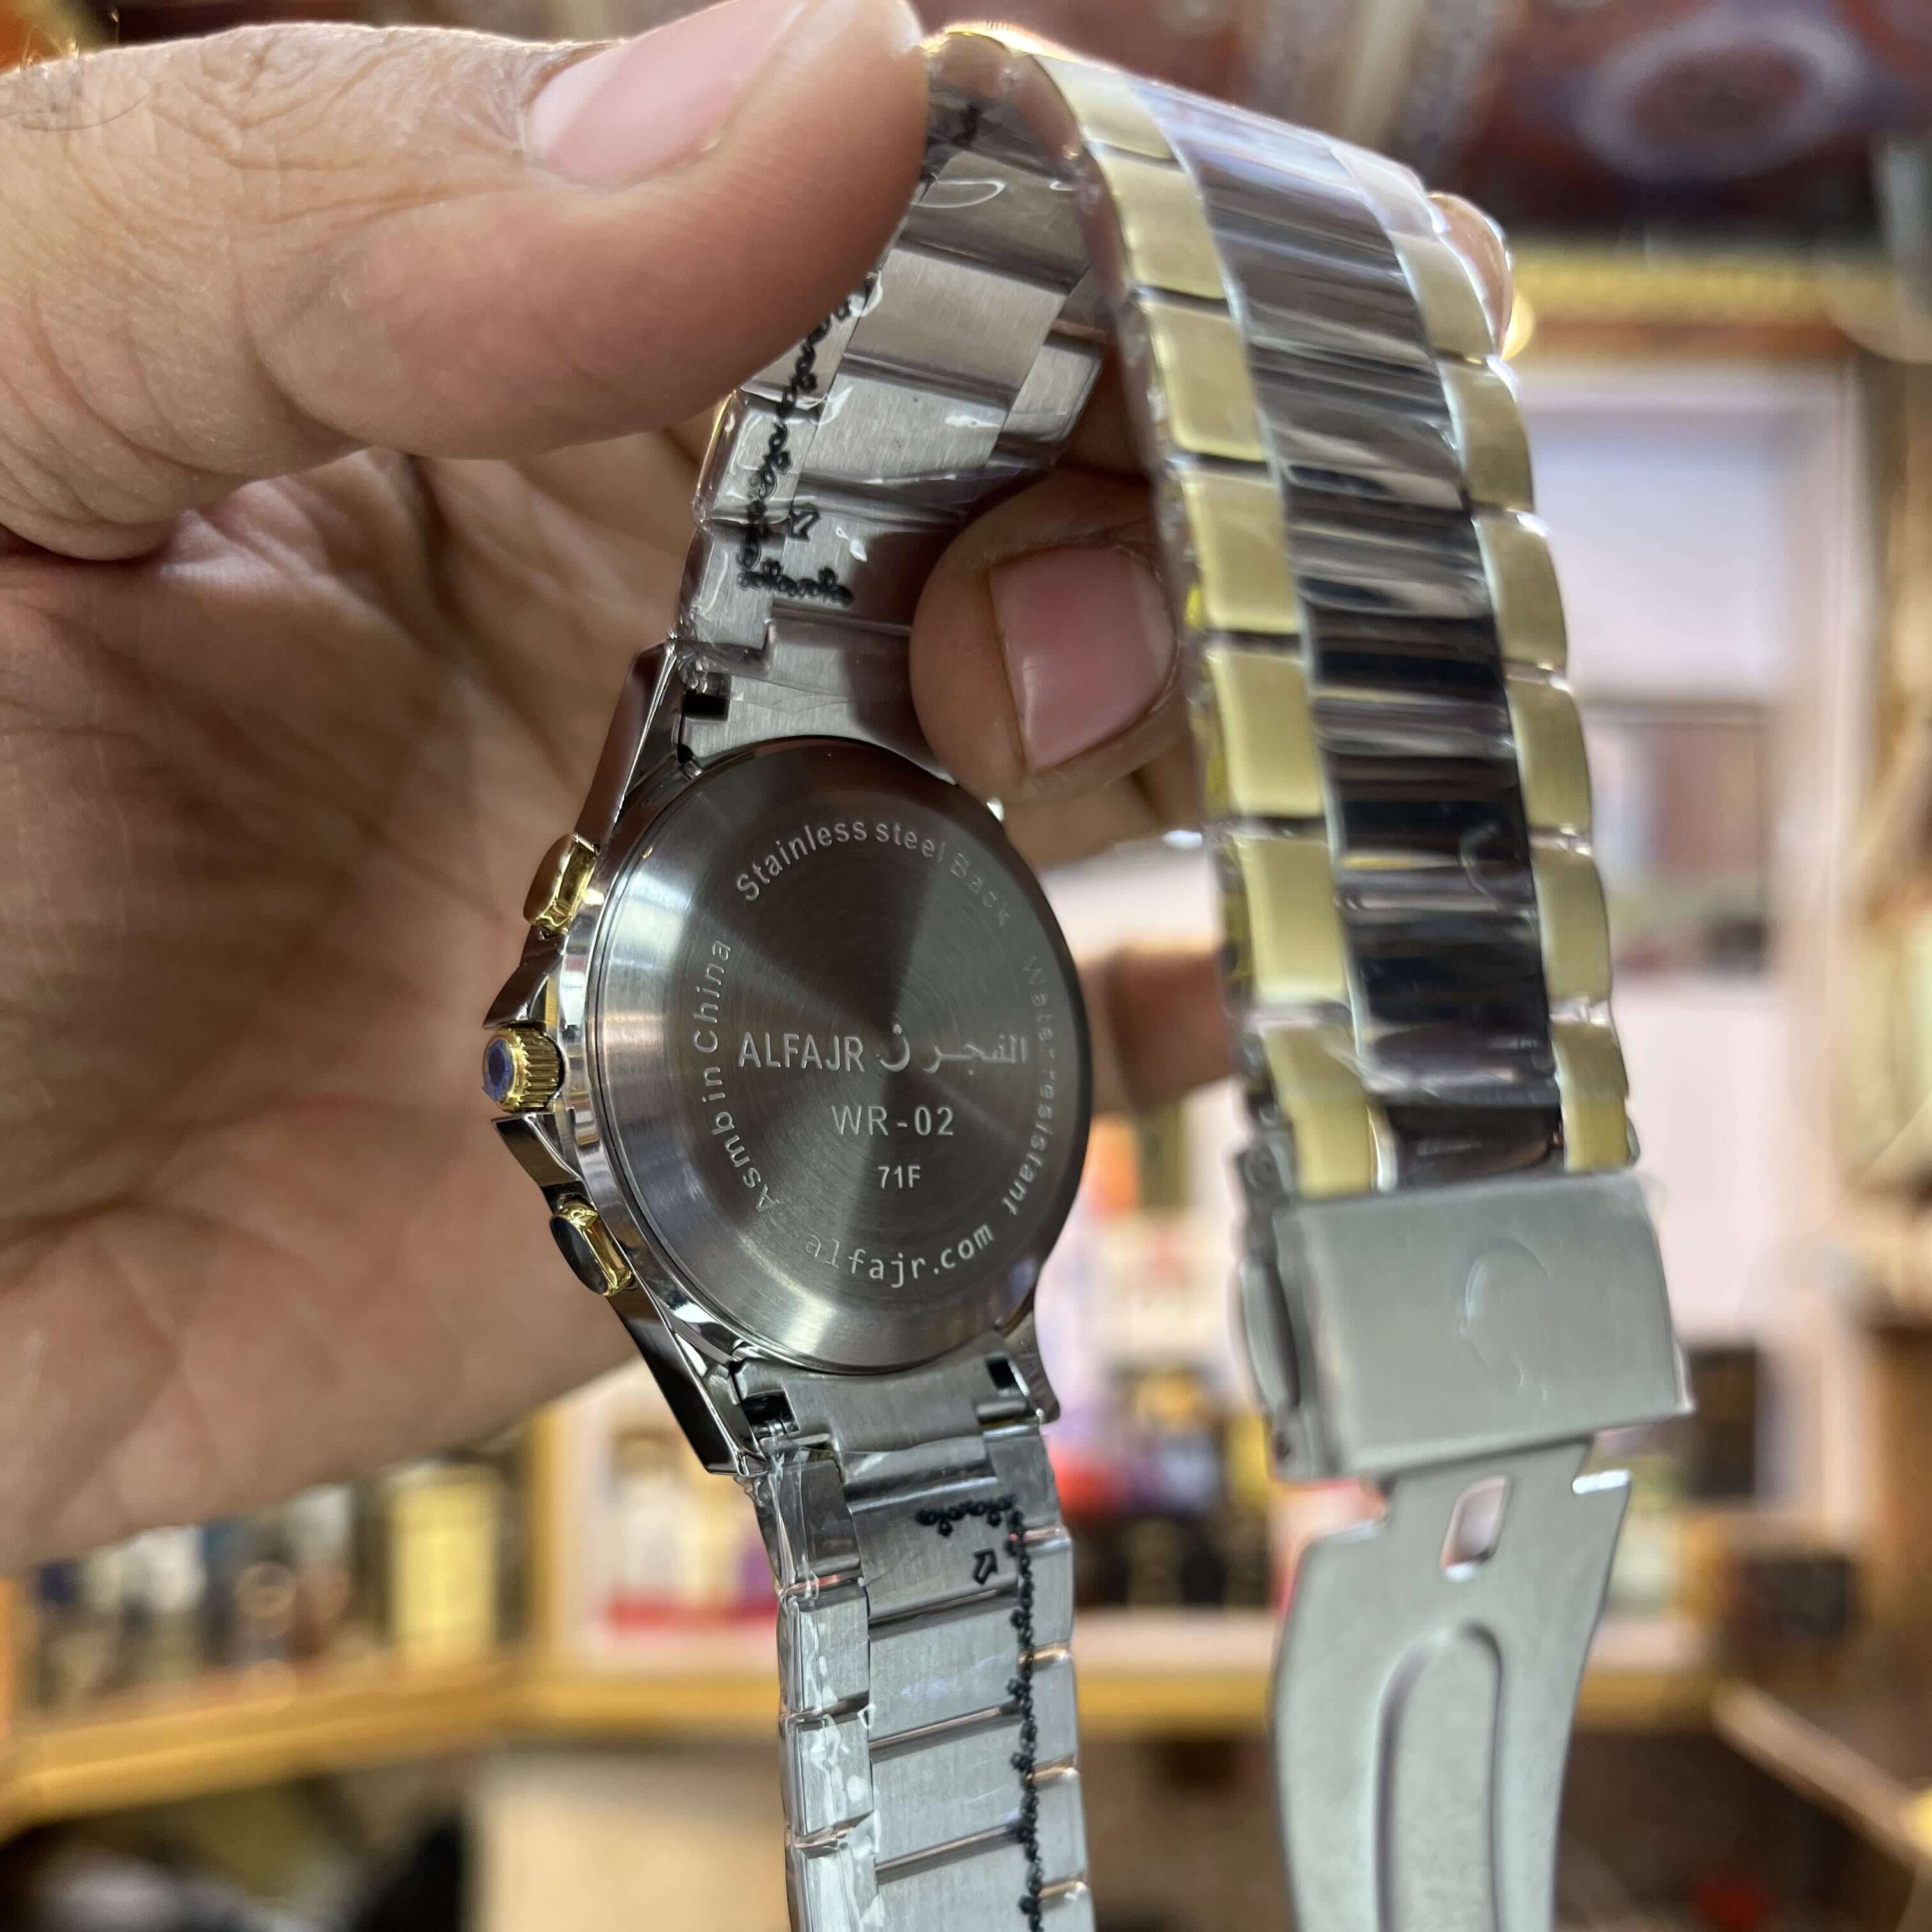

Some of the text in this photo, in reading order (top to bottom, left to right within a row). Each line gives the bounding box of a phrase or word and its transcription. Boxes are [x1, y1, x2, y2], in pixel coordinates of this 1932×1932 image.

[736, 820, 1011, 927] Stainless steel Back
[692, 940, 781, 1213] Asmb in China
[737, 1031, 866, 1073] ALFAJR
[831, 1105, 954, 1137] WR-02
[878, 1165, 922, 1190] 71F
[804, 1223, 995, 1289] alfajr.com
